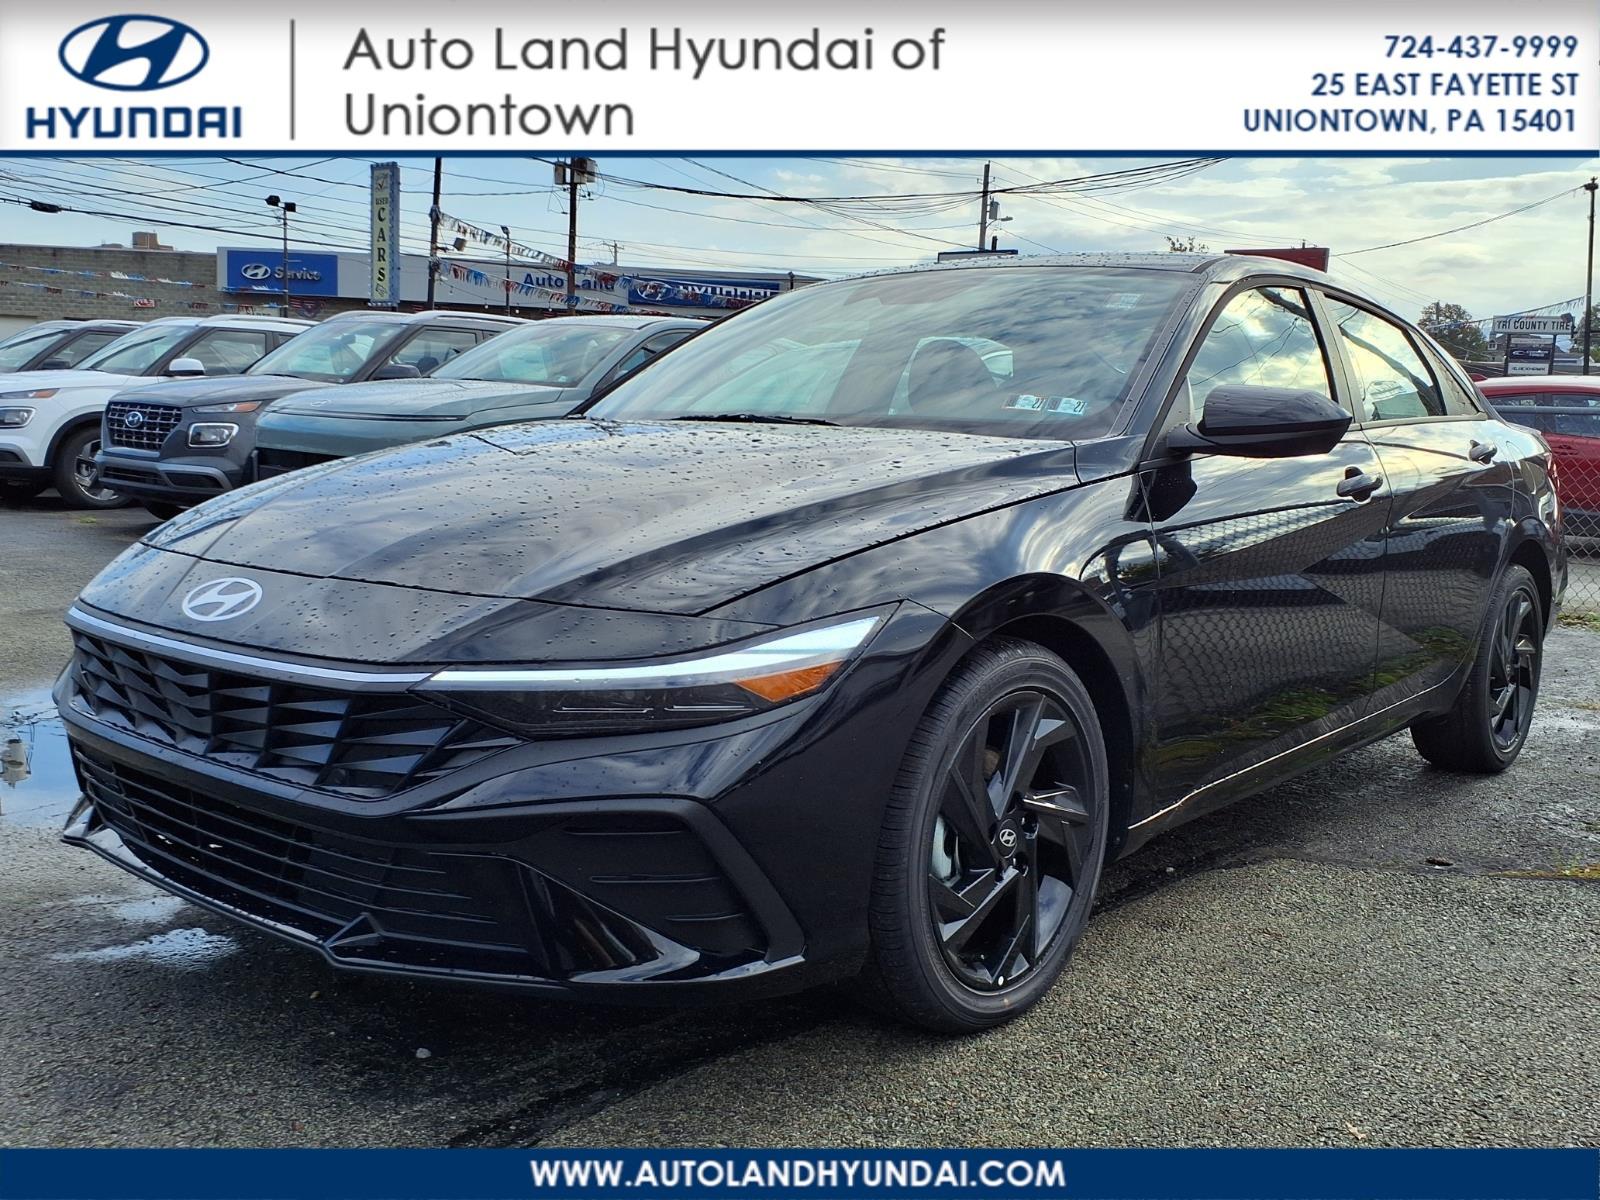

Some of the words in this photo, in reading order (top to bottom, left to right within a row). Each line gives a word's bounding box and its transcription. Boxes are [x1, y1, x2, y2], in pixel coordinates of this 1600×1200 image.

[377, 207, 386, 282] CARS
[523, 273, 564, 288] Auto
[1496, 320, 1511, 330] TRI
[1513, 320, 1547, 331] COUNTY
[1551, 320, 1571, 331] TIRE
